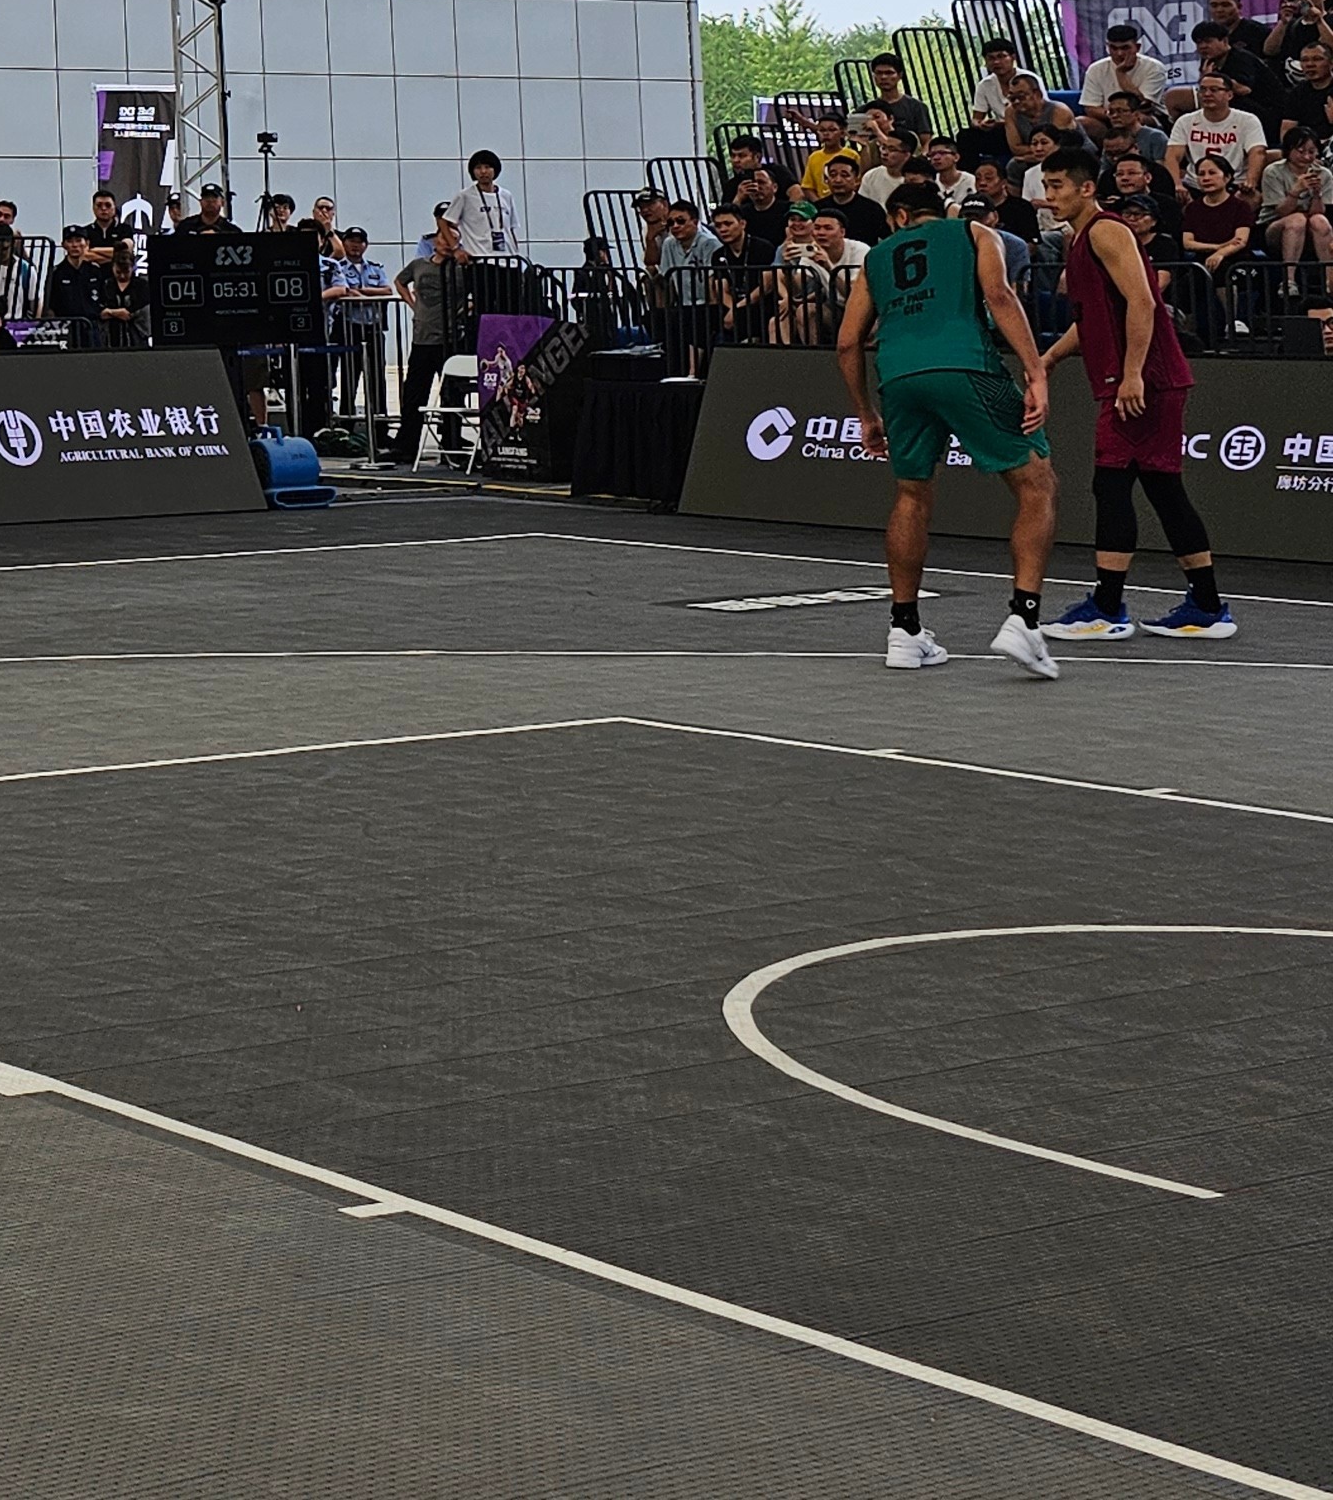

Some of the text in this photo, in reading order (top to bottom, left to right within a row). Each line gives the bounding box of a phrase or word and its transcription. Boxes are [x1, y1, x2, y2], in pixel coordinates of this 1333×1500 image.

[1190, 130, 1237, 145] CHINA
[893, 239, 929, 291] 6
[168, 281, 197, 300] 04
[213, 281, 258, 298] 05:31
[275, 278, 304, 297] 08
[297, 318, 305, 328] 3
[48, 405, 220, 442] 中国农业银行
[60, 444, 230, 463] AGRICULTURAL BANK OF CHINA
[801, 442, 844, 460] China
